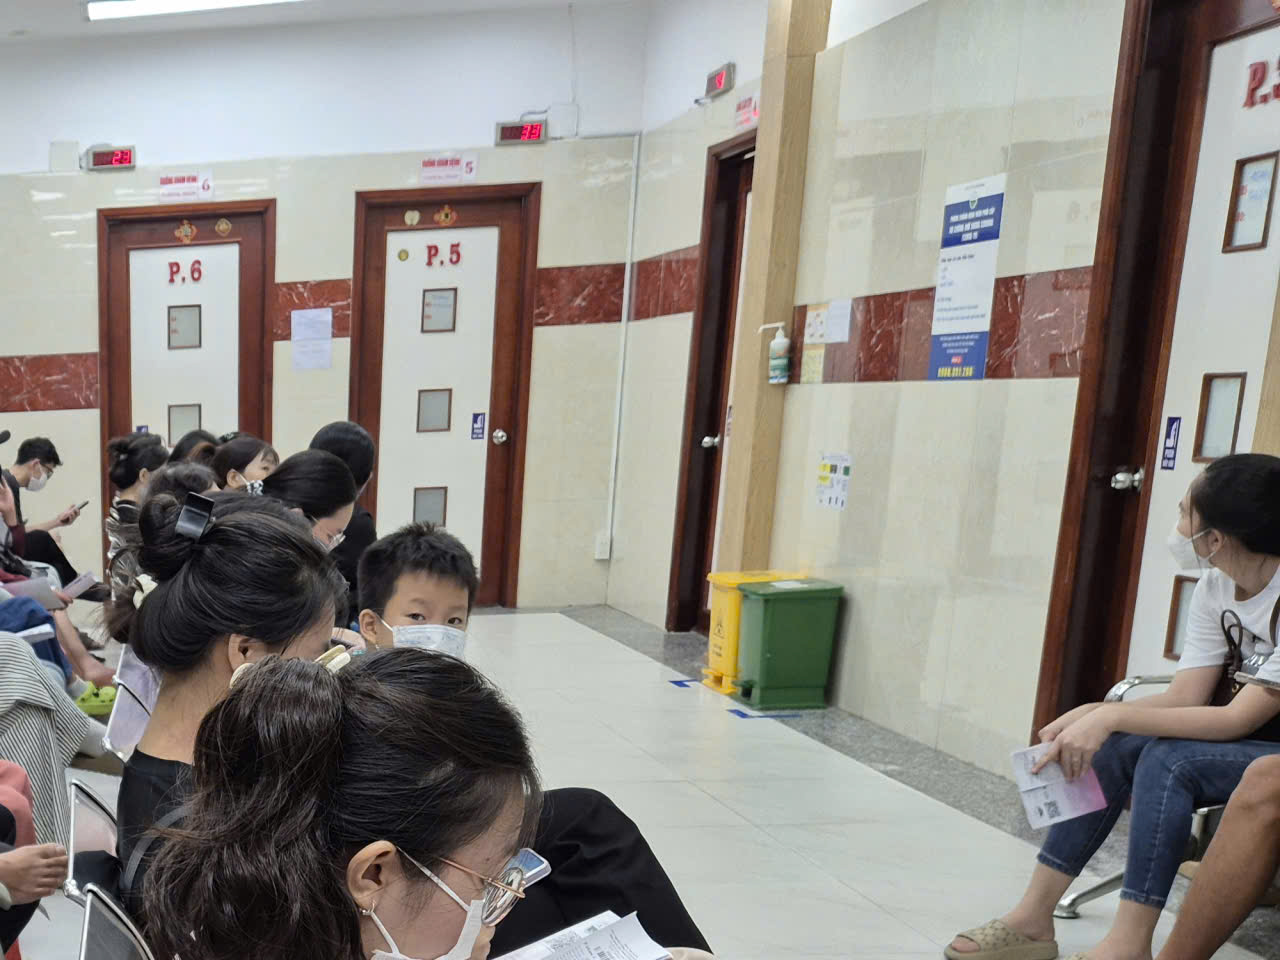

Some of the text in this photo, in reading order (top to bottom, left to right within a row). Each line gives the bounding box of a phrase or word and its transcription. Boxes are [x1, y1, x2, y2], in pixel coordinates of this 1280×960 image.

[201, 176, 210, 192] 6
[425, 242, 461, 266] P.5
[168, 260, 202, 283] P.6
